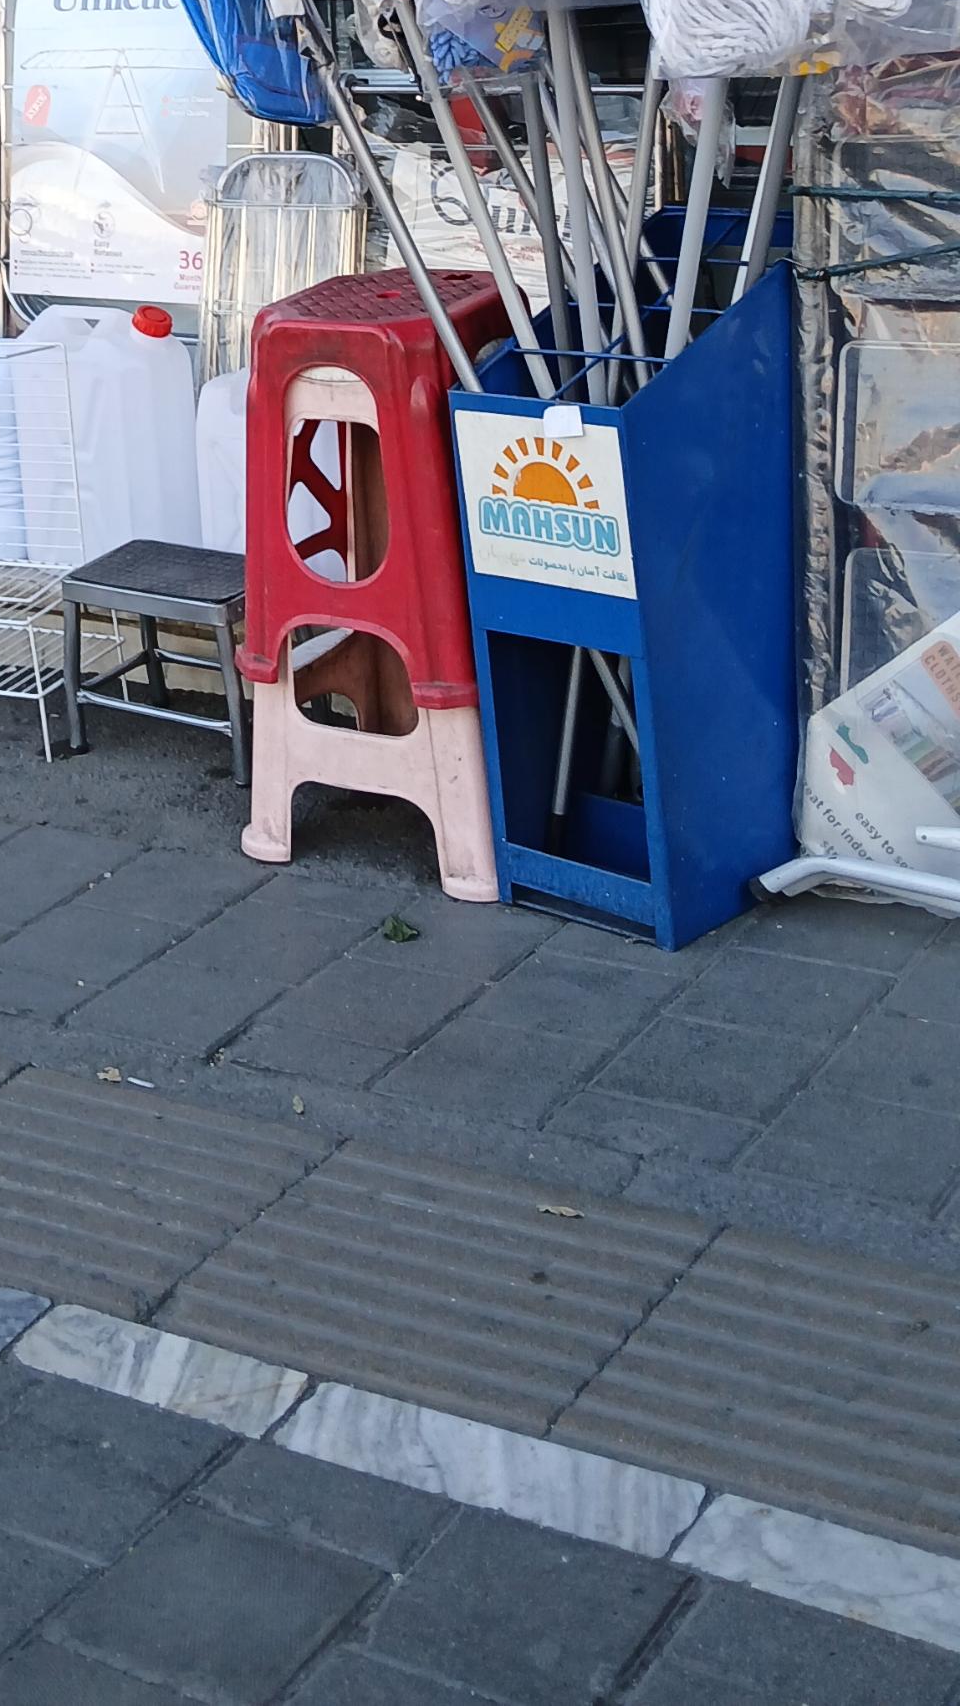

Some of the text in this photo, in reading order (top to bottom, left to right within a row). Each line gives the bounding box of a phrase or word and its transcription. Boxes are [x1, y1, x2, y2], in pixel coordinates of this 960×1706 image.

[178, 250, 204, 271] 36
[173, 282, 201, 291] Guaran
[479, 496, 621, 557] MAHSUN
[528, 556, 568, 571] محصولات
[568, 563, 575, 575] با
[577, 565, 600, 578] آسان
[601, 570, 628, 582] نظافت
[822, 808, 842, 828] for
[855, 812, 882, 840] easy
[881, 840, 895, 855] to
